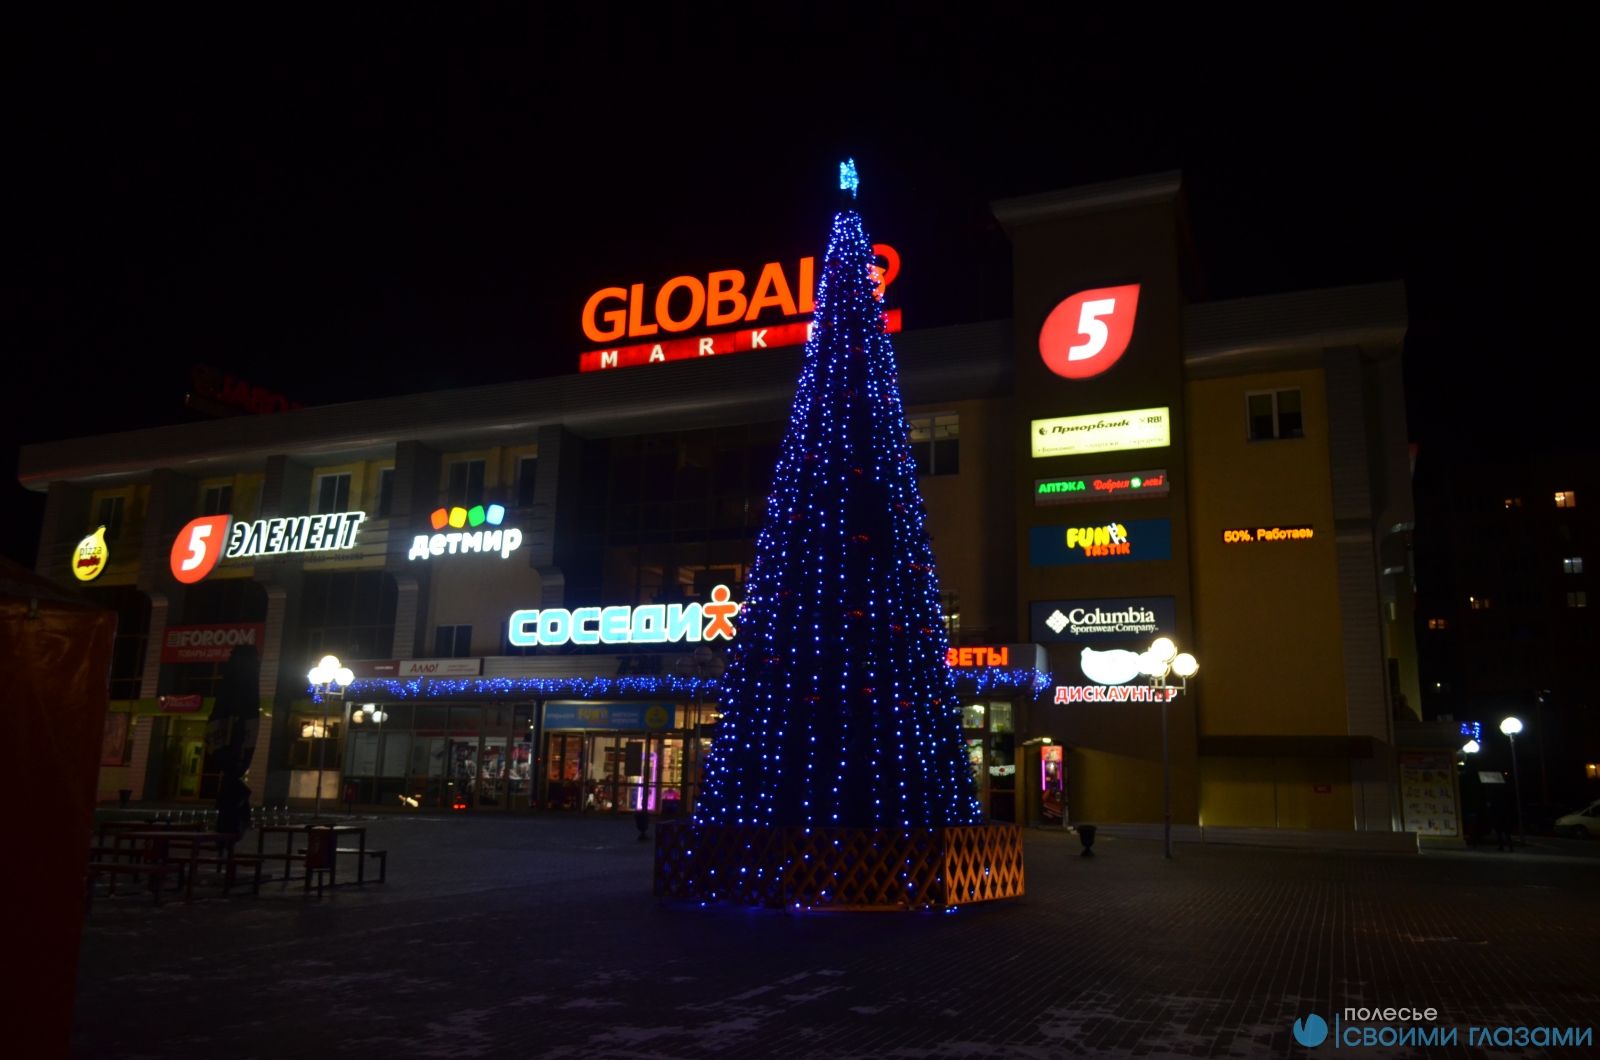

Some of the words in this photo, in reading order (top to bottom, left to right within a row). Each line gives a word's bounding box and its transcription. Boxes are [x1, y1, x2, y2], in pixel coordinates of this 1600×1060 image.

[1068, 298, 1116, 361] 5
[601, 328, 816, 369] MARK
[1051, 419, 1130, 434] Приорбанк
[1038, 480, 1086, 494] АПТЭКА
[1093, 479, 1130, 494] Добрыя
[182, 525, 212, 571] 5
[227, 511, 365, 557] ЭЛЕМЕНТ
[409, 528, 522, 560] детмир
[79, 547, 102, 559] pizza
[1069, 606, 1155, 625] Columbia
[181, 629, 256, 647] FOROOM
[1070, 624, 1116, 636] Sportswear
[947, 647, 1008, 666] ВЕТЫ
